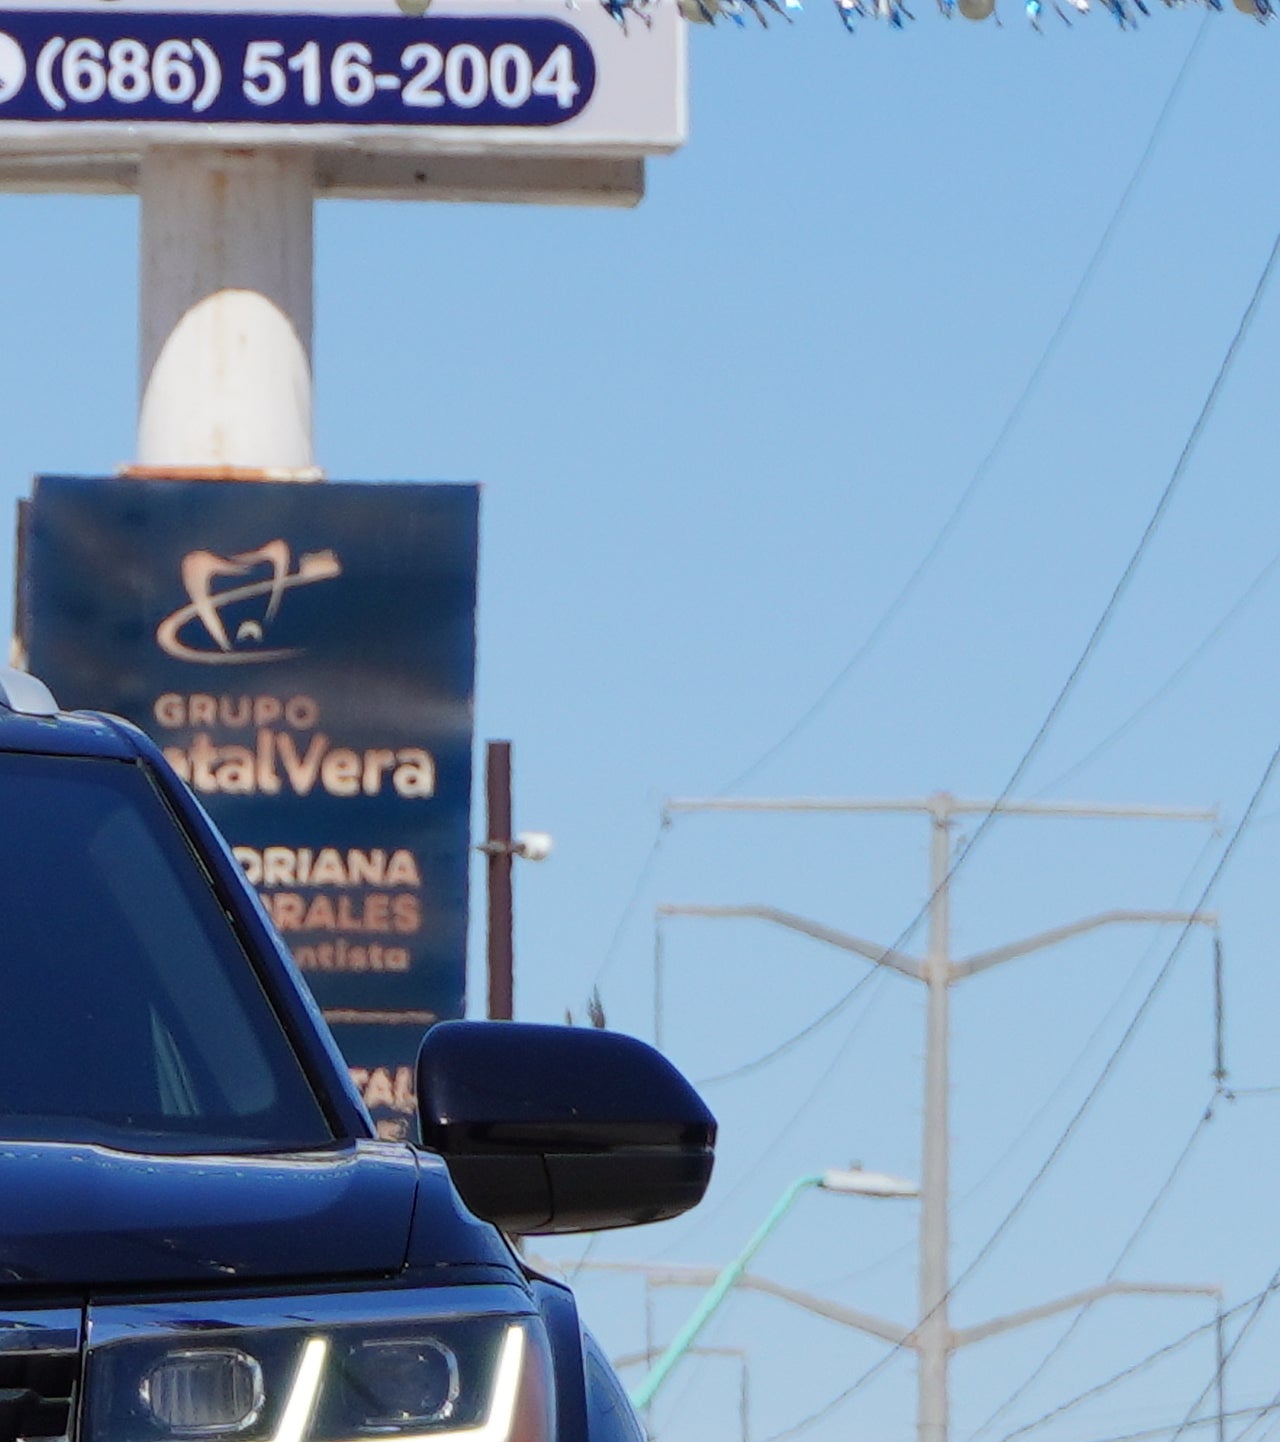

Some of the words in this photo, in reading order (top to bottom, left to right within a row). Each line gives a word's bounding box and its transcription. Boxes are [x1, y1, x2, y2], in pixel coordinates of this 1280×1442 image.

[35, 36, 222, 113] (686)
[242, 39, 579, 110] 516-2004
[153, 692, 320, 731] GRUPO
[259, 892, 419, 933] RALES
